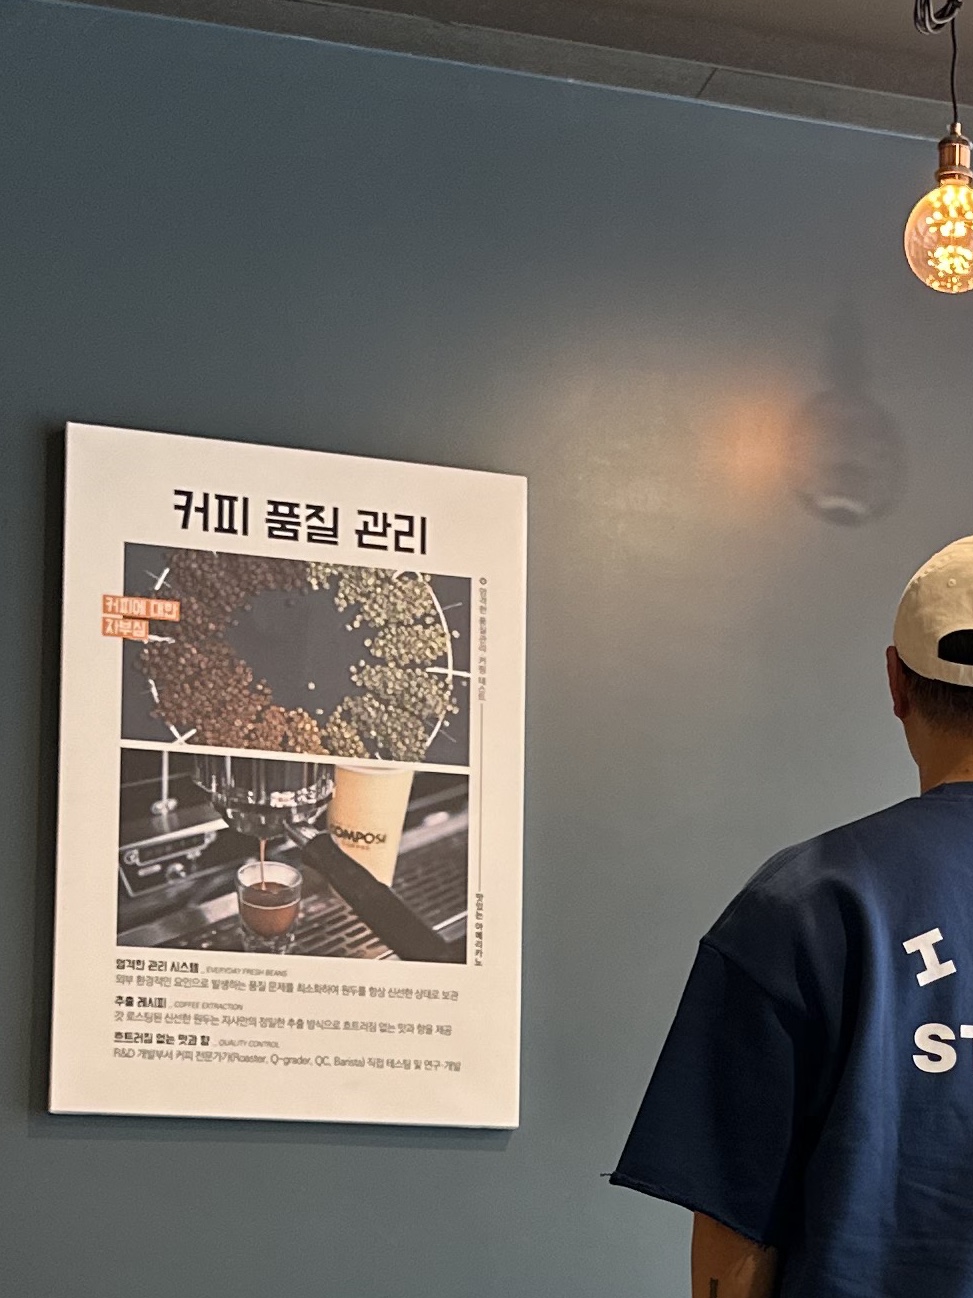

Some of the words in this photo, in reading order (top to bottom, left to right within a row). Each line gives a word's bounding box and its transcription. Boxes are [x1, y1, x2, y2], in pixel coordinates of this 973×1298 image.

[173, 489, 249, 537] 커피
[265, 499, 340, 546] 품질
[355, 508, 427, 555] 관리
[105, 596, 147, 616] 커피에
[150, 600, 178, 620] 대한
[105, 618, 147, 638] 자부심
[148, 960, 168, 972] 관리
[170, 962, 199, 973] 시스템
[174, 976, 209, 989] 요인으로
[115, 995, 134, 1007] 추출
[137, 996, 167, 1009] 레시피
[156, 1033, 175, 1045] 없는
[113, 1047, 136, 1059] R&D
[176, 1050, 193, 1062] 커피
